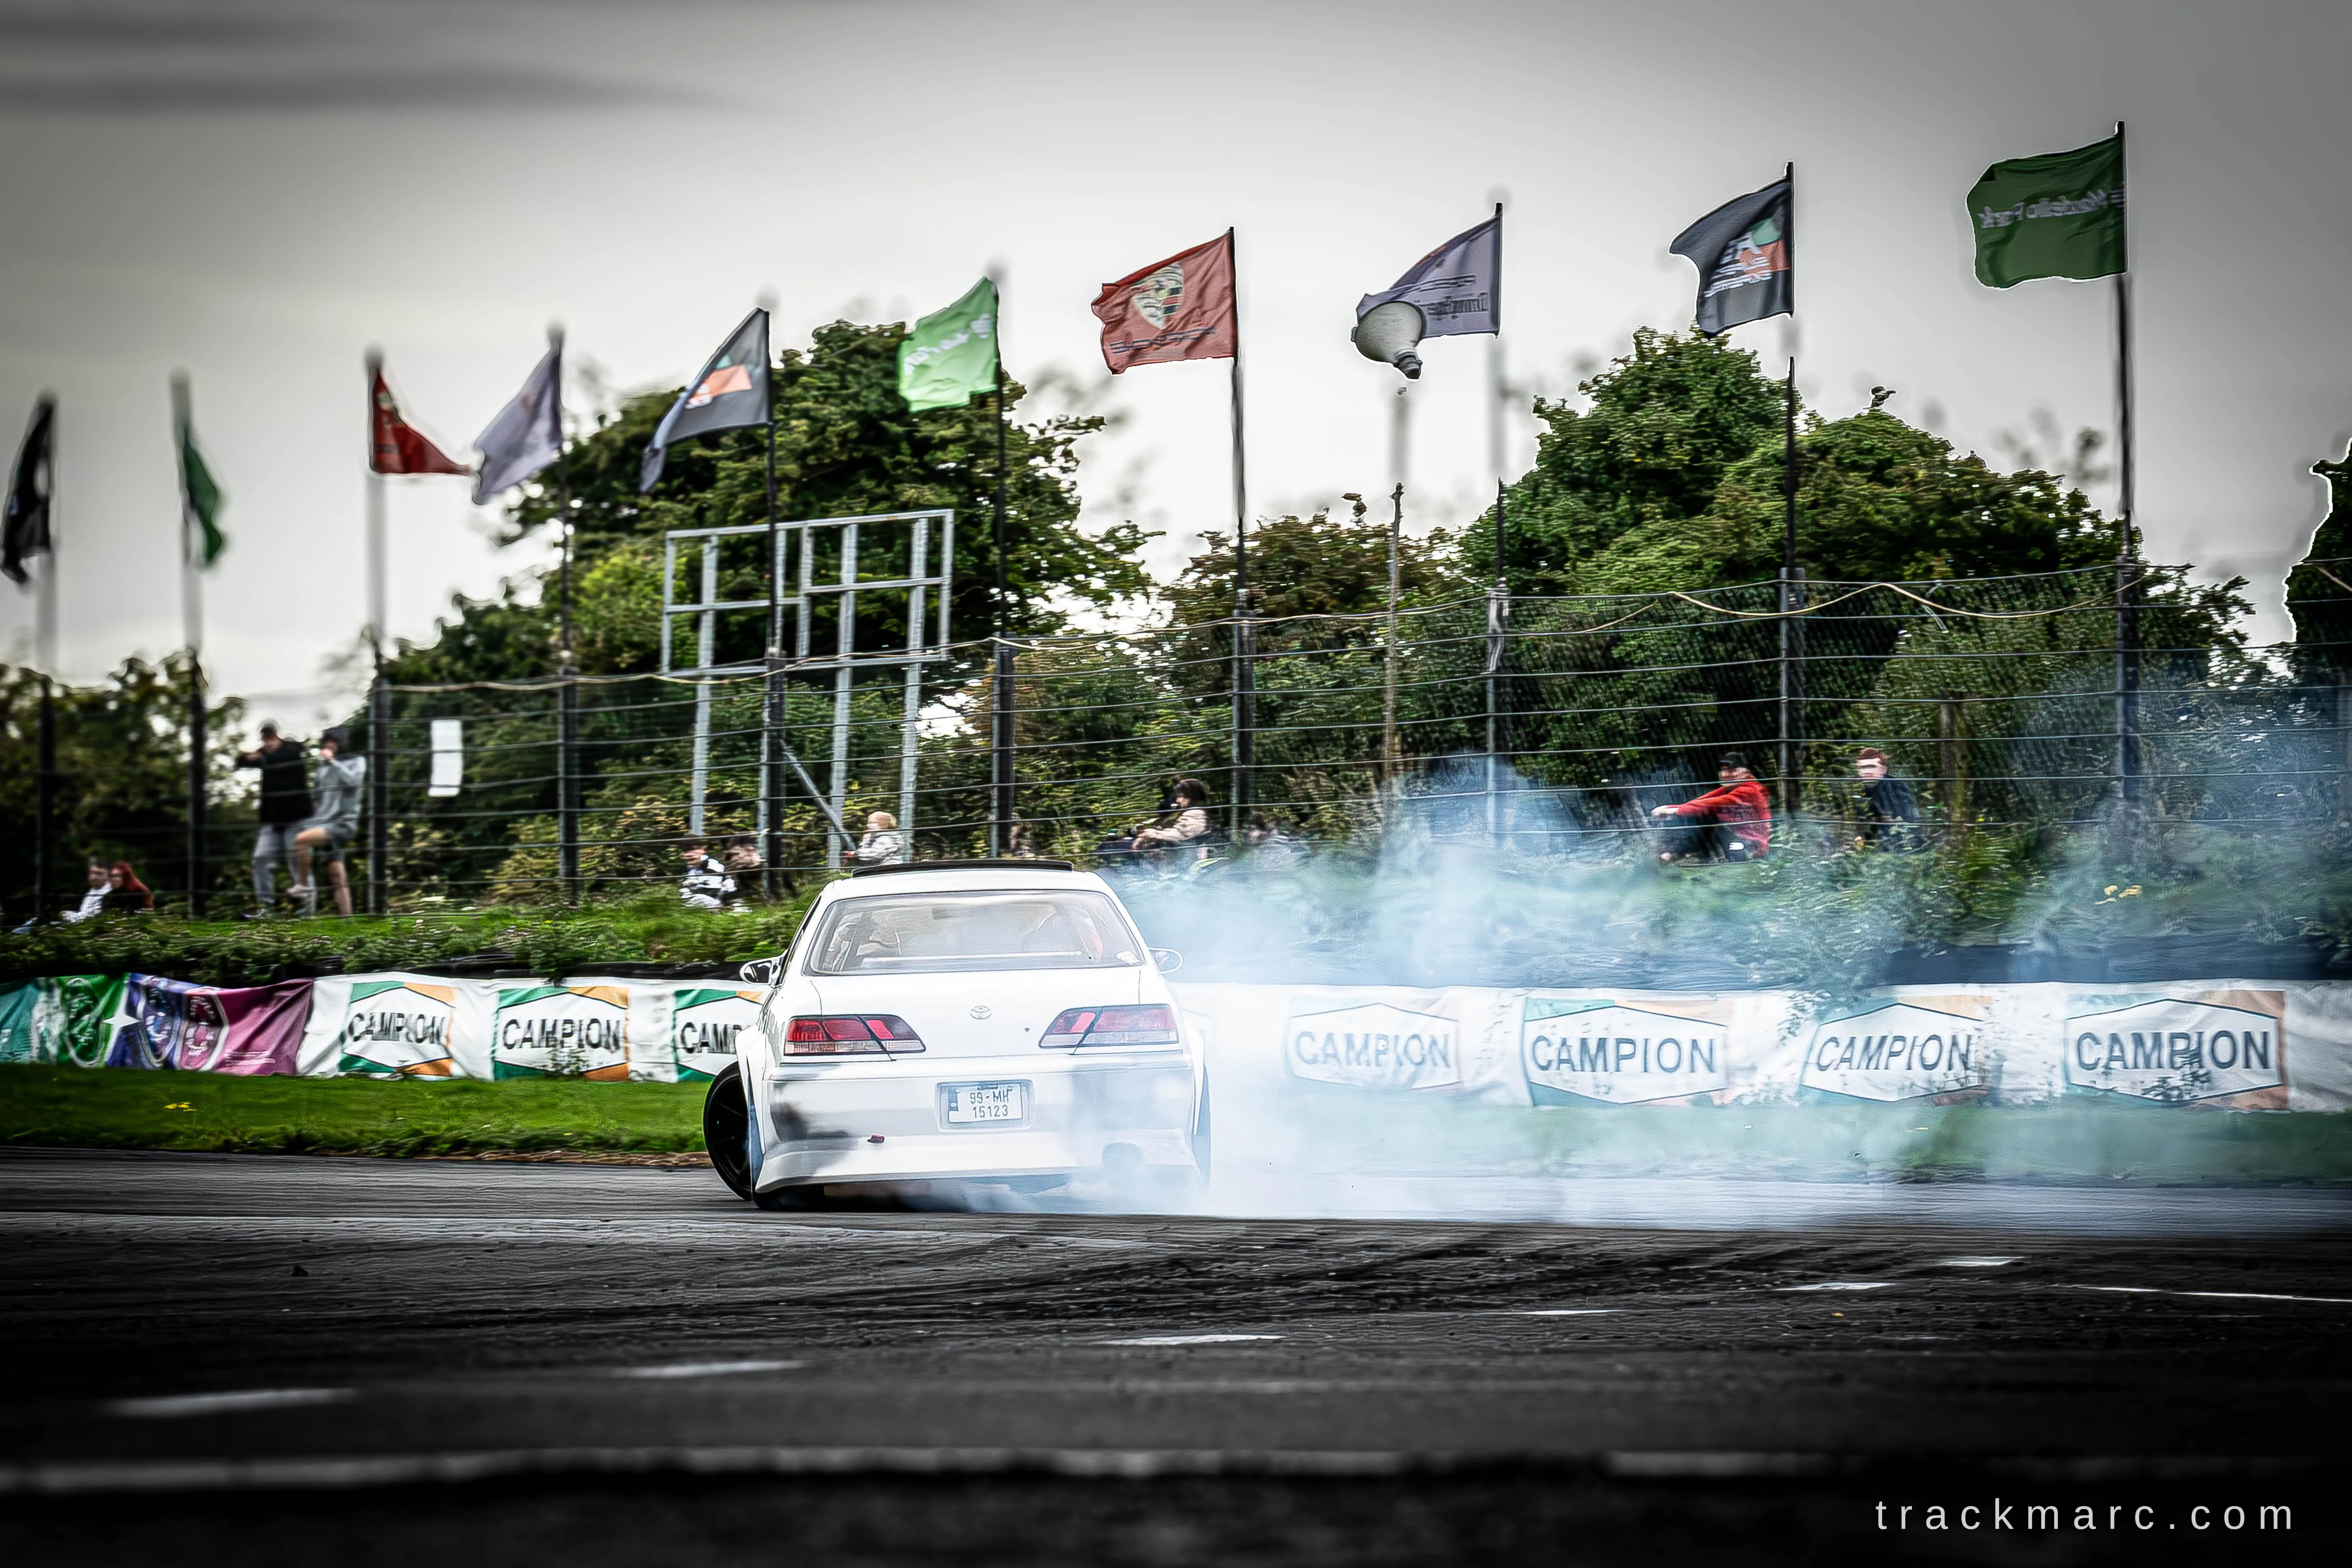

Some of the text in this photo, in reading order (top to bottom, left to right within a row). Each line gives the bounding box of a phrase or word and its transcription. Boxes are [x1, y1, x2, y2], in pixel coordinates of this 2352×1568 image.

[503, 1018, 620, 1051] CAMPION
[1295, 1031, 1451, 1068] CAMPION
[1818, 1034, 1973, 1071] CAMPION
[2077, 1030, 2270, 1070] CAMPION
[1532, 1036, 1715, 1073] CAMPION
[972, 1105, 1009, 1118] 15123
